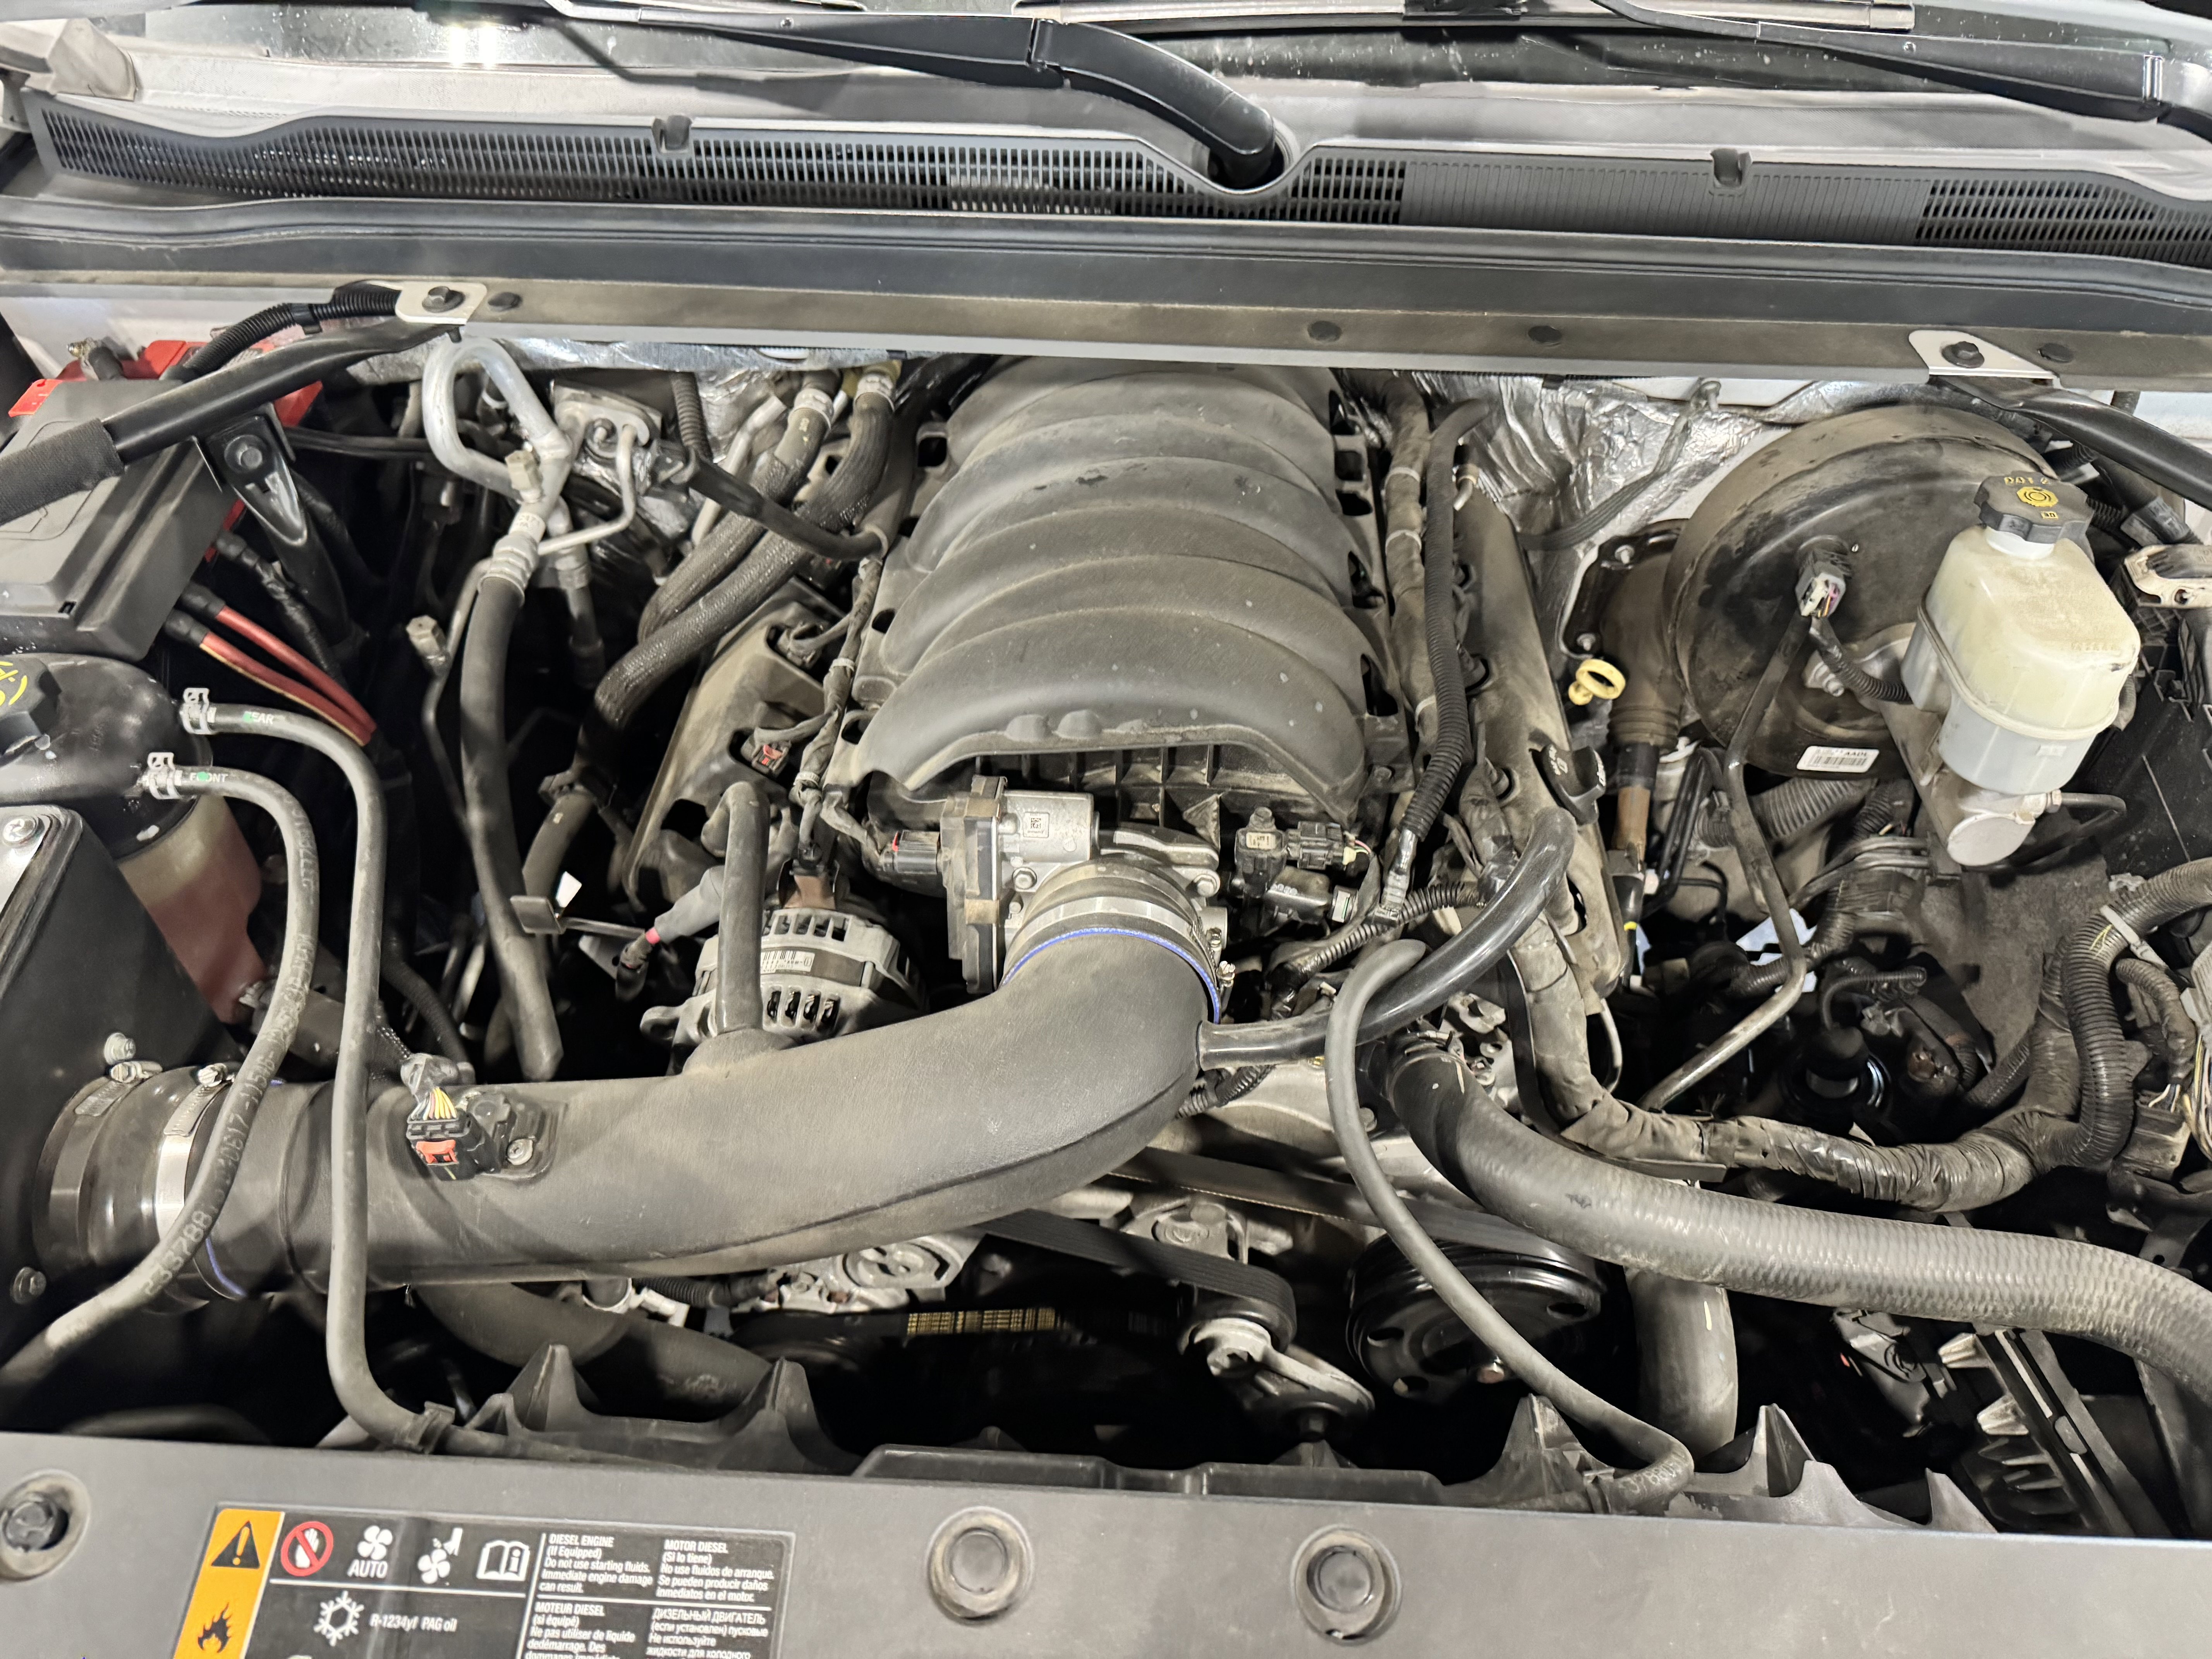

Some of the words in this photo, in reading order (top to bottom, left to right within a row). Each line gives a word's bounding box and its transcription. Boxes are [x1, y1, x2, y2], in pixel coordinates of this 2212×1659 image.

[244, 711, 274, 725] EAR
[190, 772, 229, 783] FONT
[549, 1533, 580, 1546] DIESEL
[581, 1535, 614, 1547] ENGINE
[664, 1539, 696, 1551] MOTOR
[697, 1541, 729, 1554] DIESEL
[558, 1546, 602, 1559] Equipped)
[662, 1551, 675, 1563] (Si
[676, 1553, 685, 1563] lo
[687, 1553, 712, 1565] tiene)
[347, 1559, 388, 1578] AUTO
[544, 1557, 556, 1568] Do
[558, 1558, 572, 1568] not
[574, 1560, 589, 1570] use
[590, 1560, 623, 1573] starting
[624, 1561, 650, 1573] fluids.
[661, 1563, 673, 1574] No
[675, 1566, 690, 1575] use
[692, 1565, 720, 1577] fluidos
[721, 1566, 733, 1577] de
[734, 1568, 774, 1580] arranque.
[541, 1569, 587, 1581] Immediate
[588, 1573, 617, 1585] engine
[618, 1573, 653, 1587] damage
[658, 1575, 670, 1585] Se
[671, 1577, 704, 1588] pueden
[705, 1578, 741, 1590] producir
[742, 1580, 768, 1591] daños
[539, 1582, 556, 1592] can
[556, 1583, 584, 1593] result.
[656, 1588, 704, 1600] inmediatos
[705, 1591, 716, 1600] en
[717, 1590, 726, 1601] el
[727, 1592, 754, 1602] motor.
[534, 1602, 573, 1614] MOTEUR
[574, 1603, 605, 1616] DIESEL
[652, 1607, 711, 1622] ДИЗЕЛЬНЫЙ
[711, 1611, 766, 1625] ДВИГАТЕЛЬ
[369, 1613, 419, 1632] R-1234yf
[421, 1616, 442, 1631] PAG
[443, 1618, 457, 1632] oil
[532, 1614, 545, 1625] (si
[545, 1614, 580, 1628] équipé)
[530, 1626, 543, 1637] Ne
[544, 1628, 561, 1638] pas
[562, 1628, 592, 1640] utiliser
[592, 1630, 604, 1641] de
[605, 1630, 636, 1644] liquide
[650, 1620, 675, 1633] (если
[676, 1624, 727, 1637] установлен)
[588, 1641, 606, 1654] Des
[648, 1633, 662, 1644] Не
[663, 1635, 716, 1648] используйте
[646, 1647, 687, 1657] жидкости
[687, 1649, 705, 1659] для
[706, 1650, 751, 1659] холодного
